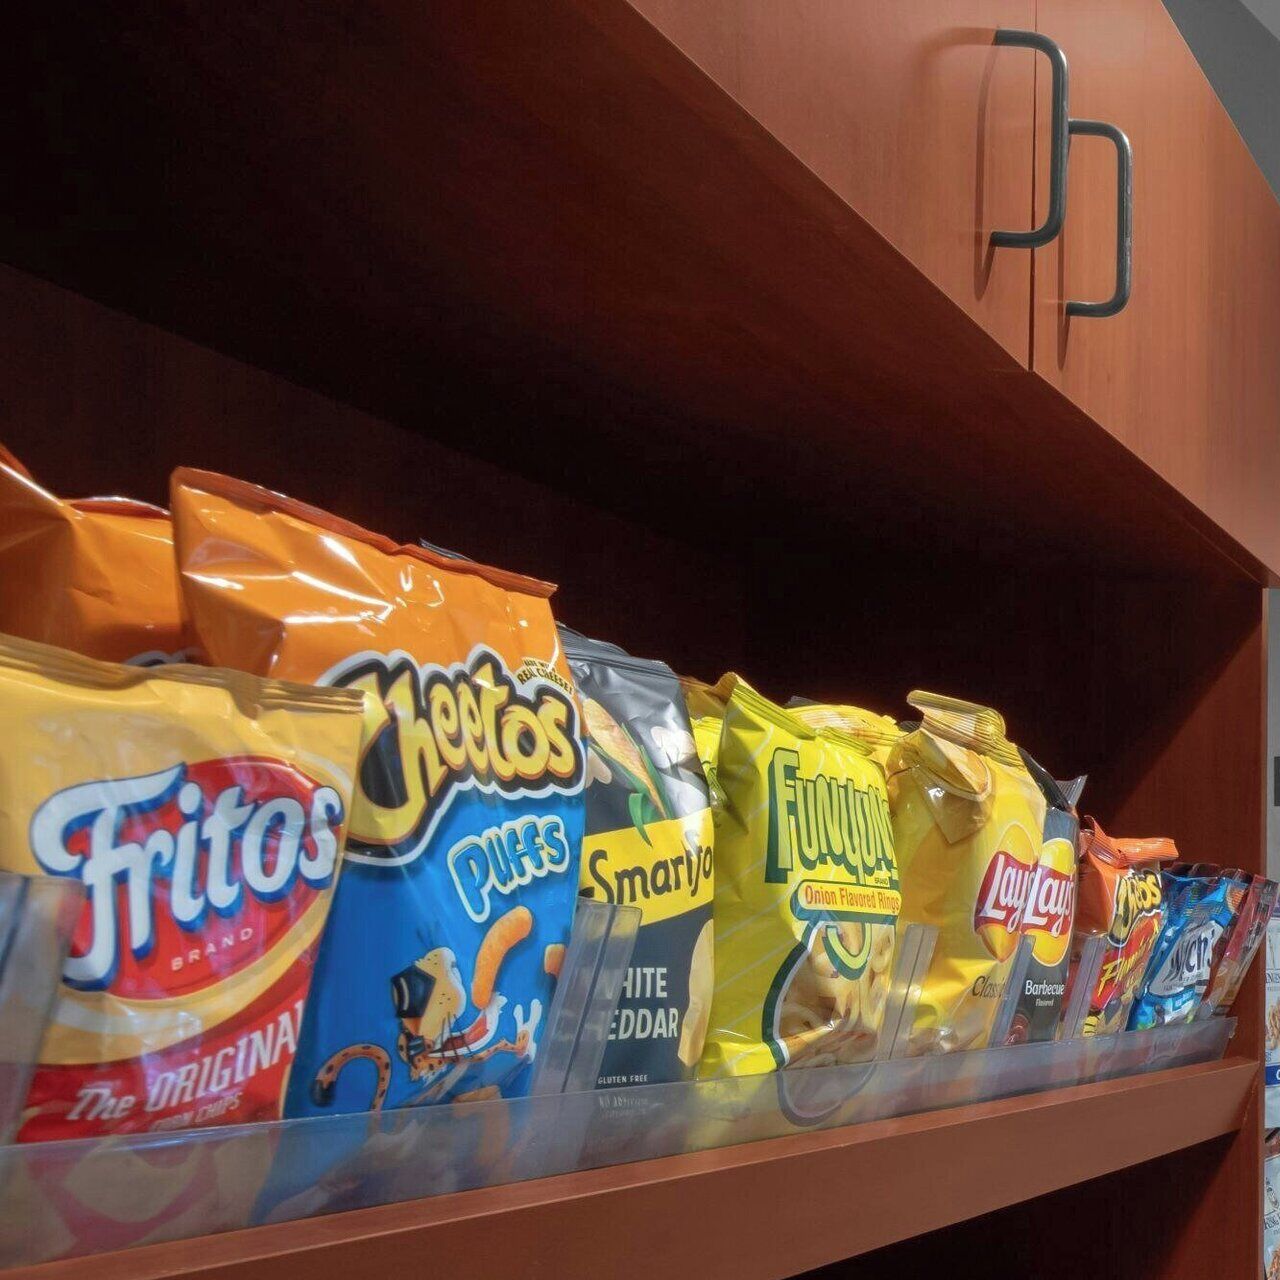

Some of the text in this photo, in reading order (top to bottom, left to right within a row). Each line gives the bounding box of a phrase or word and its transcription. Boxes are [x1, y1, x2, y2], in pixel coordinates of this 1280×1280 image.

[342, 655, 580, 848] Cheetos
[29, 760, 346, 993] Fritos
[804, 884, 900, 914] Onion Flavored Rings
[170, 926, 254, 972] BRAND
[620, 967, 669, 999] HITE
[1024, 979, 1065, 999] Barbecue
[606, 1006, 679, 1042] EDDAR
[597, 1073, 649, 1086] GLUTEN FREE
[66, 1084, 137, 1121] The
